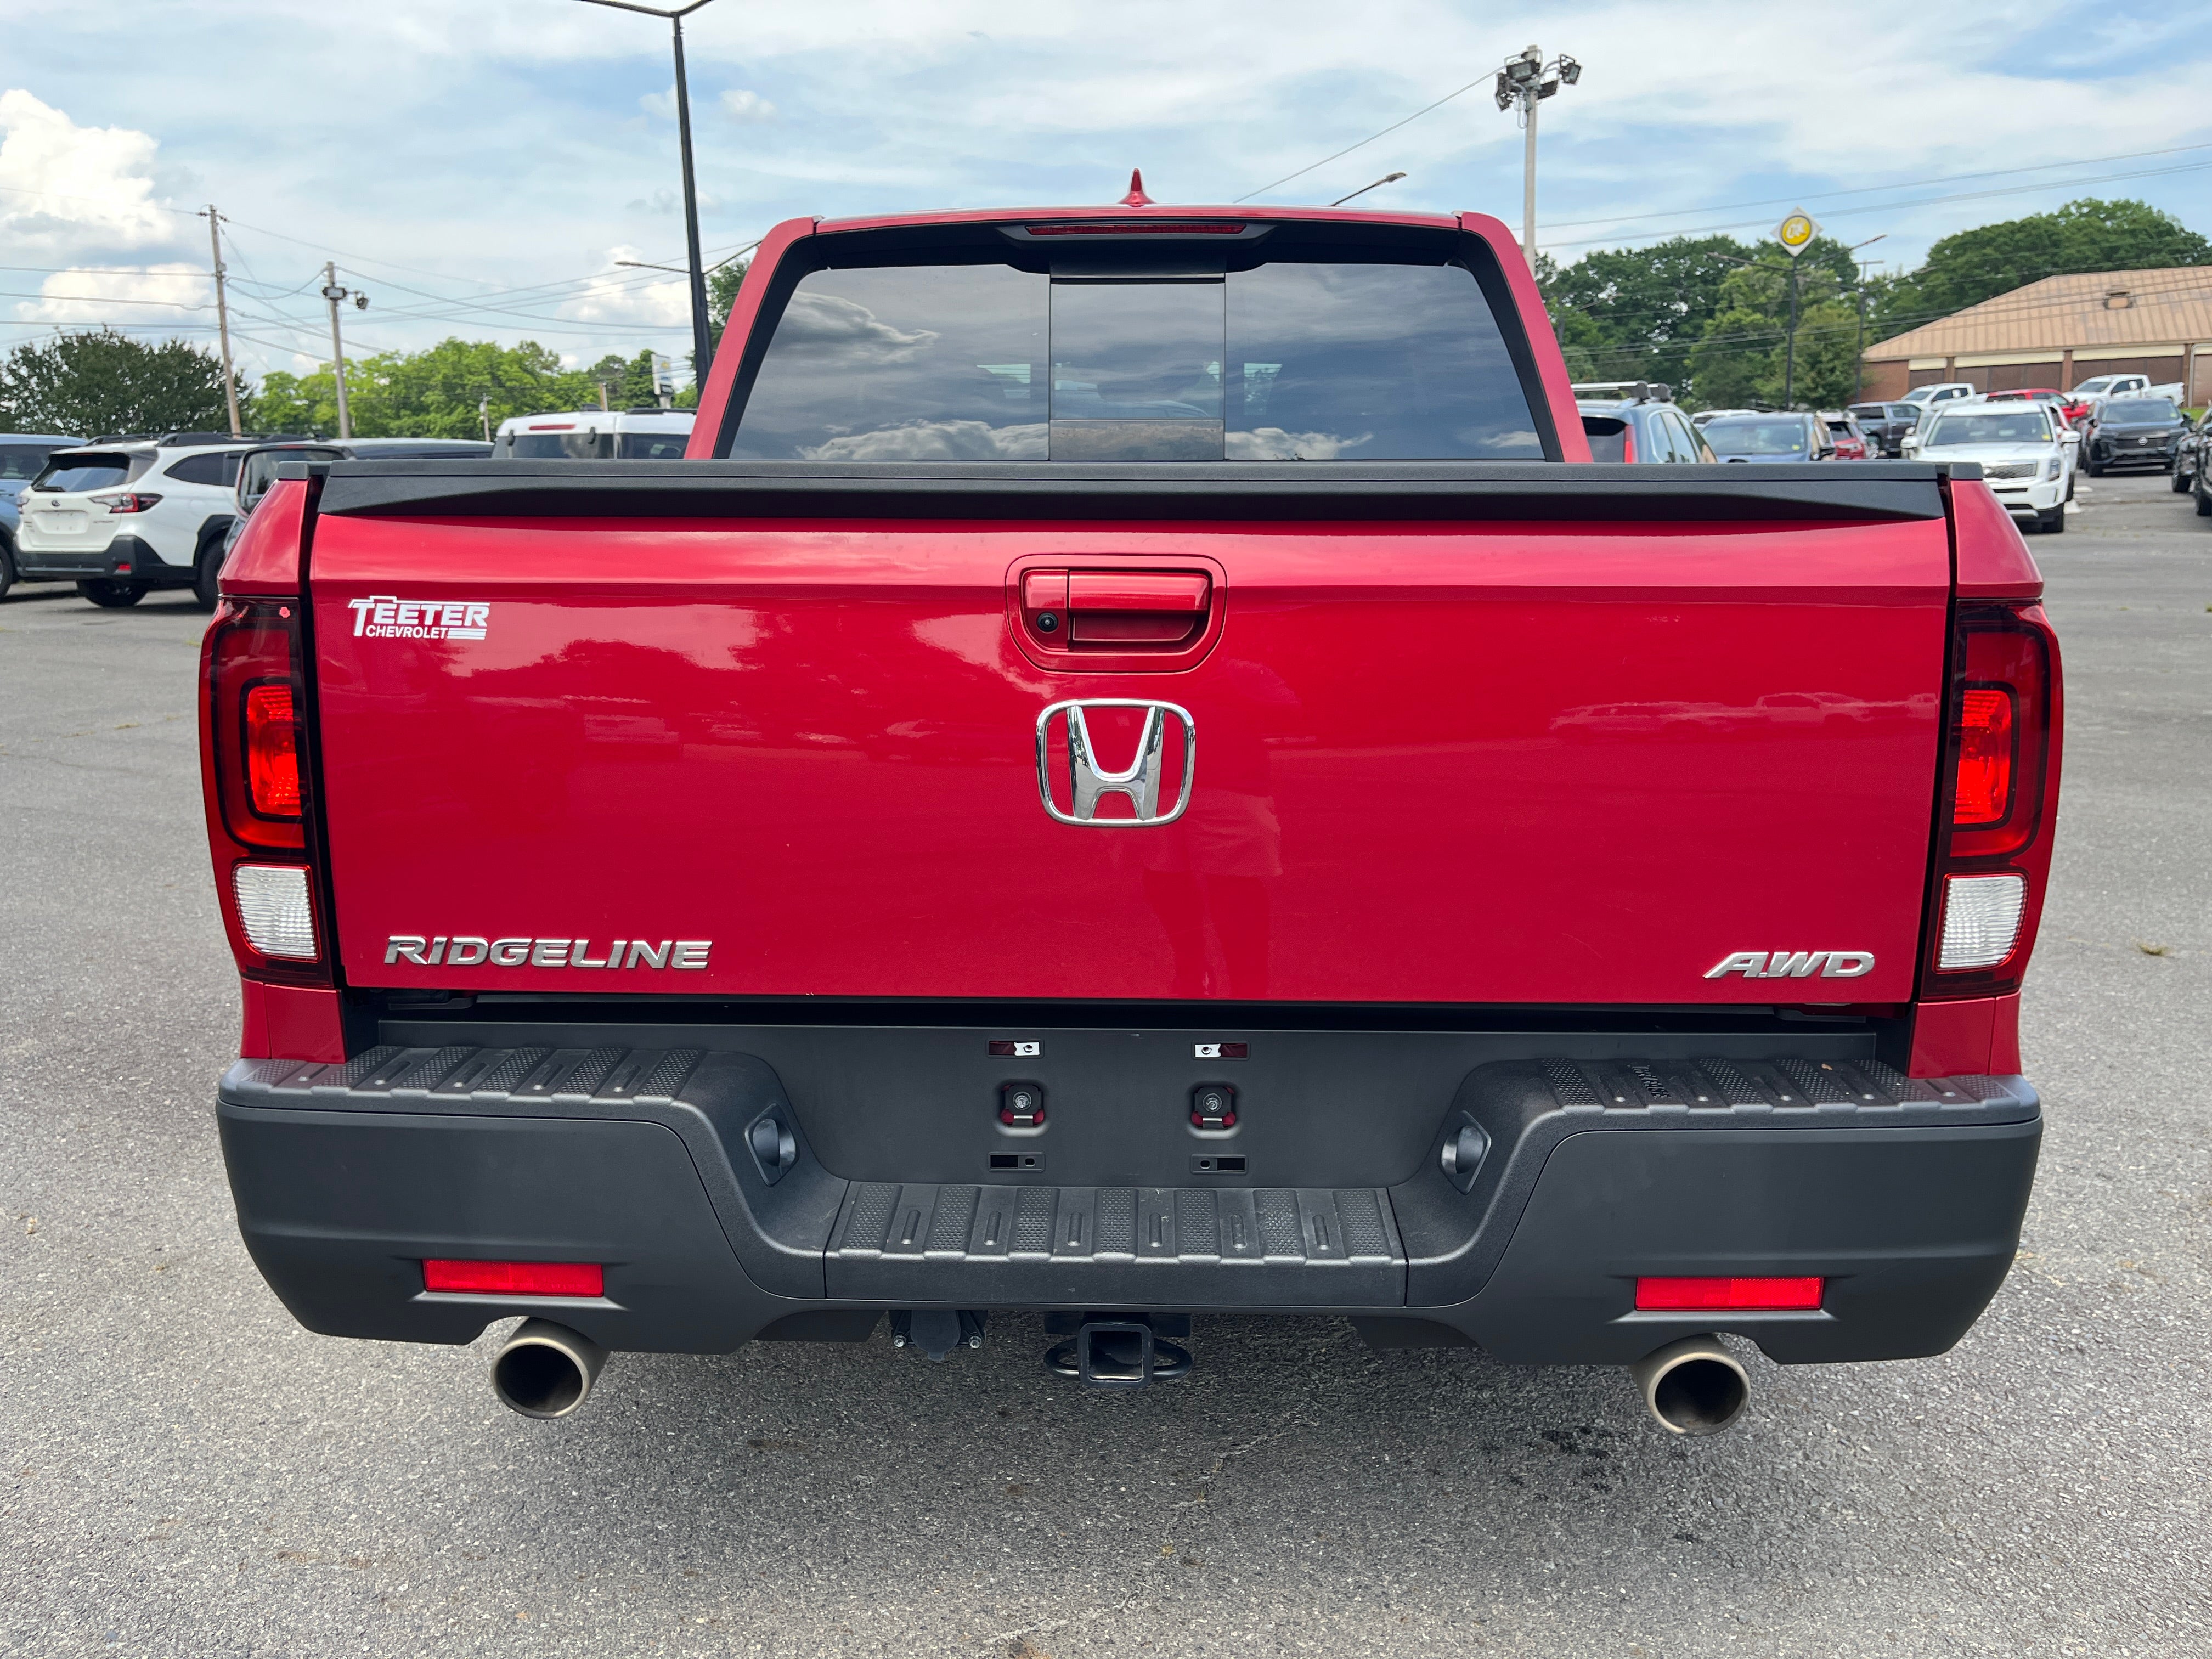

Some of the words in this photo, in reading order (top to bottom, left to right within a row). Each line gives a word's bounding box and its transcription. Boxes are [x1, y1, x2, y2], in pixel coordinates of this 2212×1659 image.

[349, 600, 490, 637] TEETER
[365, 625, 449, 639] CHEVROLET
[384, 936, 713, 969] RIDGELINE
[1702, 951, 1875, 978] AWD
